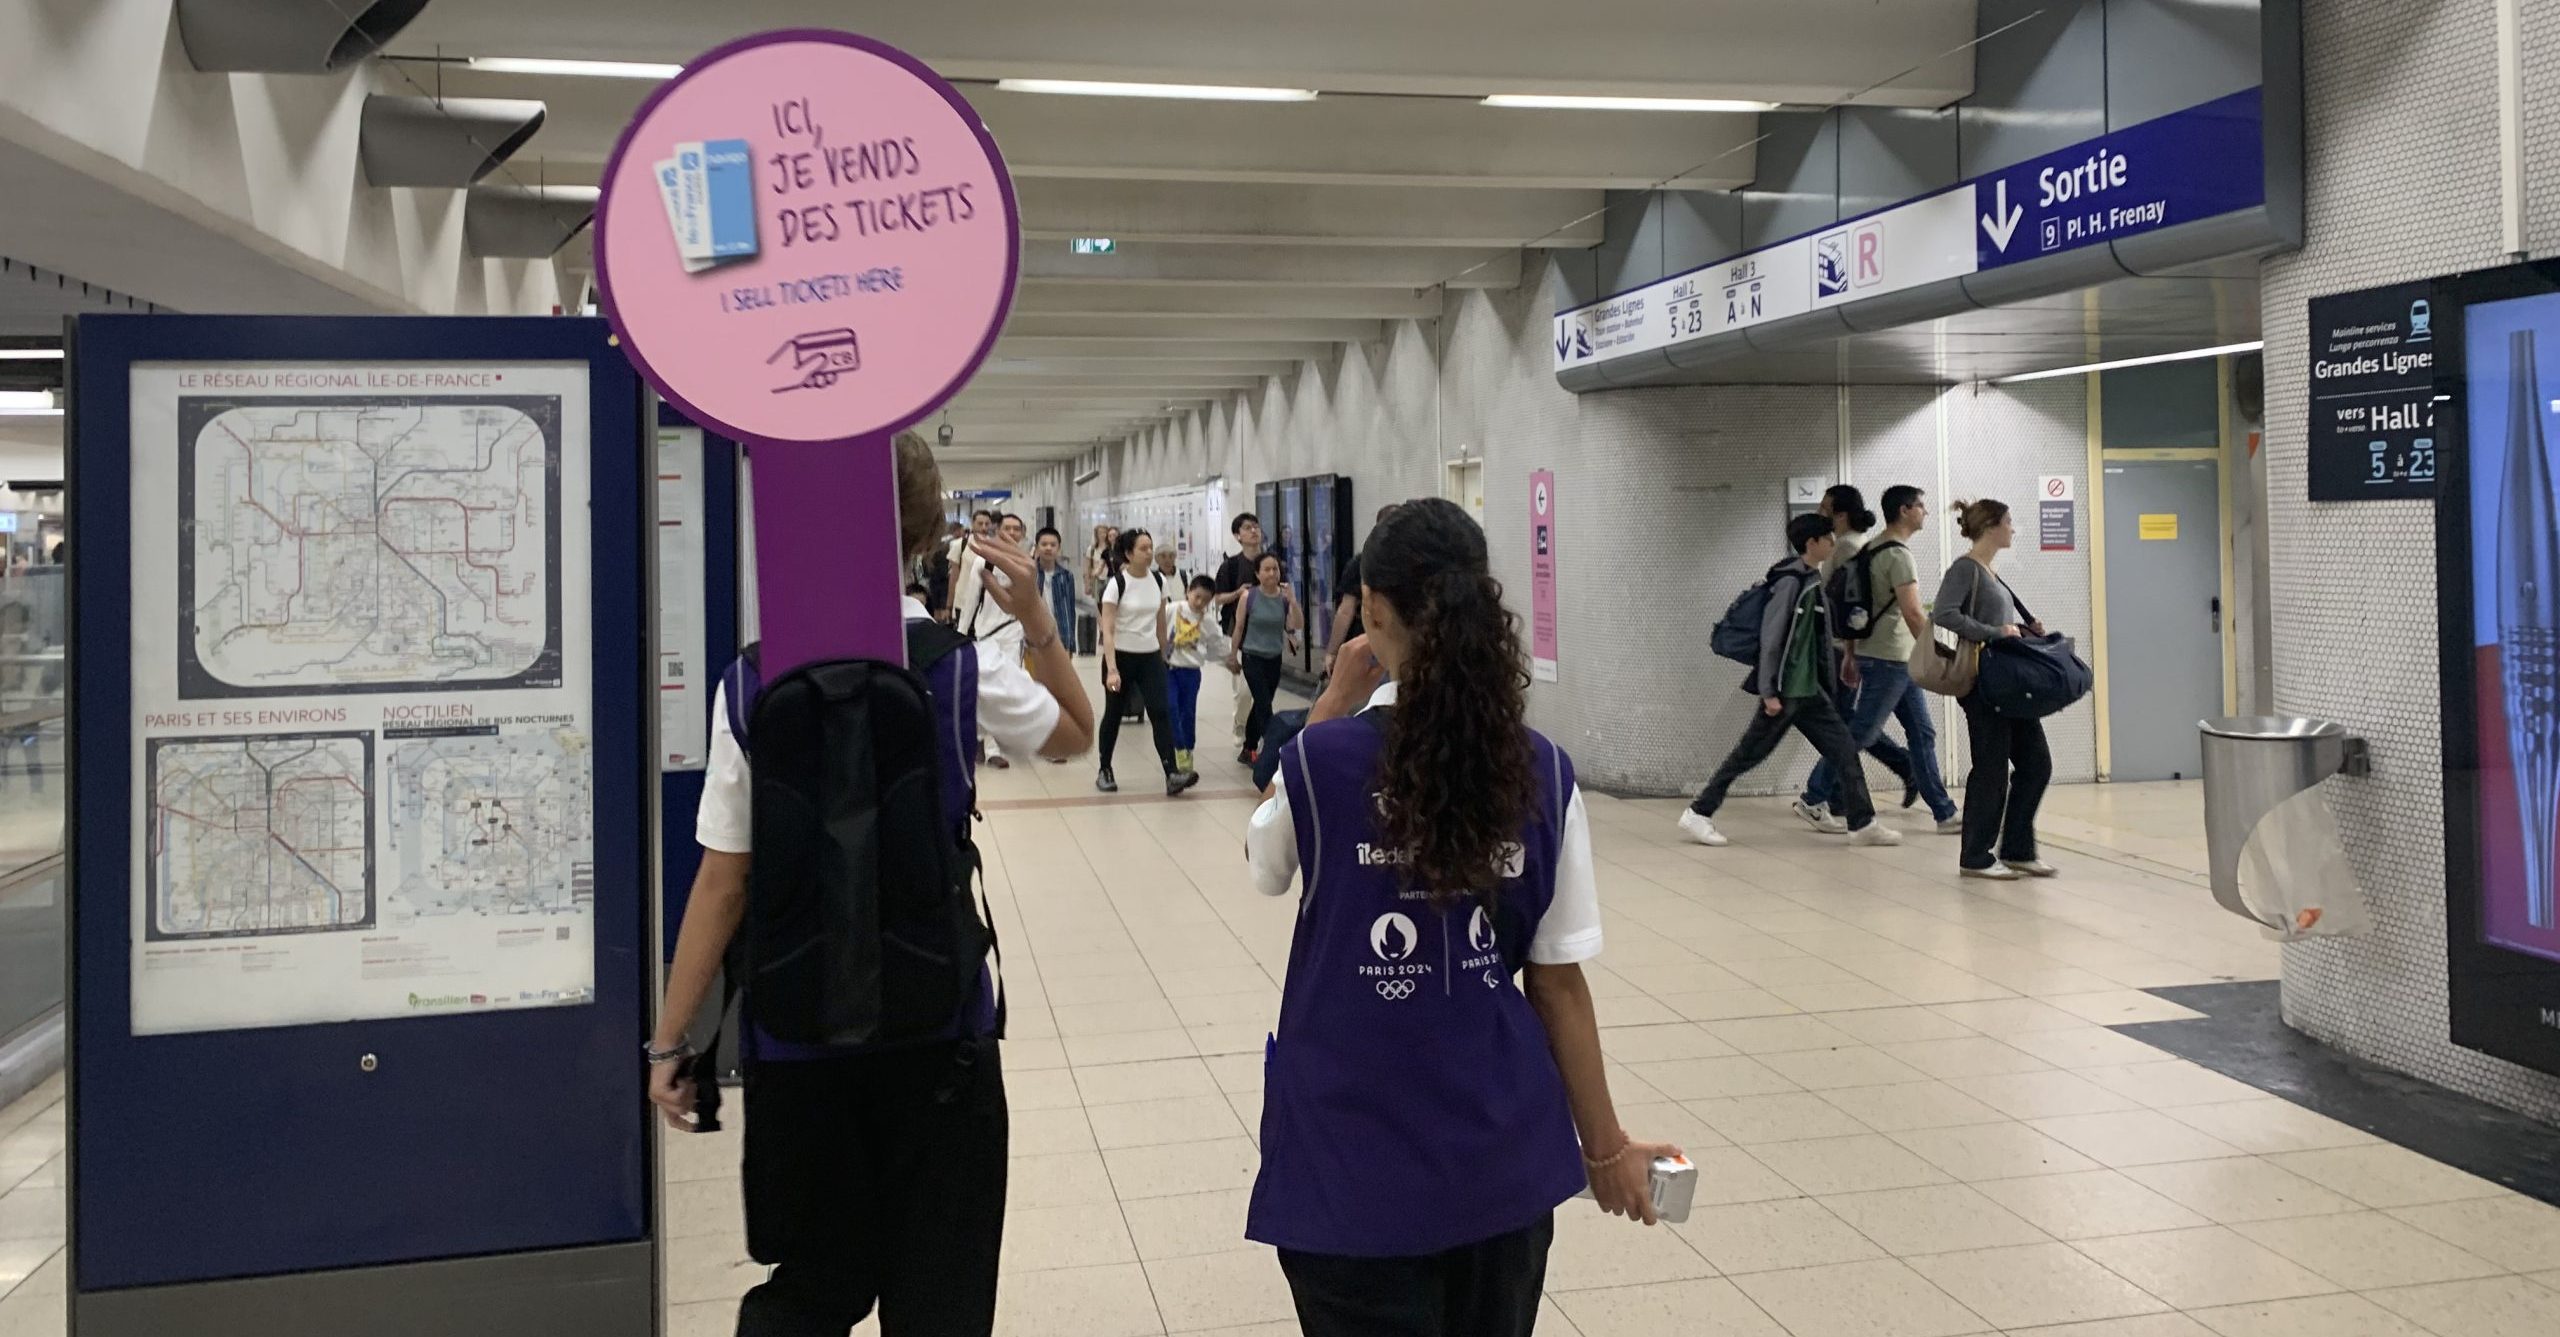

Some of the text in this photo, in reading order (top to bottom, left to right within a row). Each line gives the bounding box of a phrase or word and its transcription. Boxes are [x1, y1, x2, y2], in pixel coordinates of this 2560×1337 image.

[771, 96, 823, 149] ICI,
[768, 136, 921, 195] JE VENDS
[2039, 148, 2127, 208] Sortie
[777, 181, 976, 248] DES TICKETS
[2046, 200, 2166, 244] 9 Pl. H. Frenay
[1858, 232, 1879, 279] R
[1731, 261, 1756, 282] Hall 3
[719, 267, 904, 314] I SELL TICKETS HERE
[1673, 280, 1694, 299] Hall 2
[1594, 298, 1645, 323] Grandes Lignes
[1727, 301, 1736, 324] A
[1751, 293, 1761, 318] N
[1670, 316, 1677, 338] 5
[1688, 309, 1702, 334] 23
[2332, 321, 2397, 338] Mainline services
[178, 371, 490, 388] LE RÉSEAU RÉGIONAL ÎLE-DE-FRANCE
[2315, 356, 2380, 379] Grandes
[2336, 407, 2365, 420] vers
[2371, 403, 2420, 431] Hall
[2372, 452, 2386, 478] 5
[2409, 450, 2434, 477] 23
[145, 707, 347, 728] PARIS ET SES ENVIRONS
[515, 714, 575, 724] NOCTURNES
[1359, 964, 1432, 976] PARIS 2024
[1462, 955, 1490, 970] PARIS
